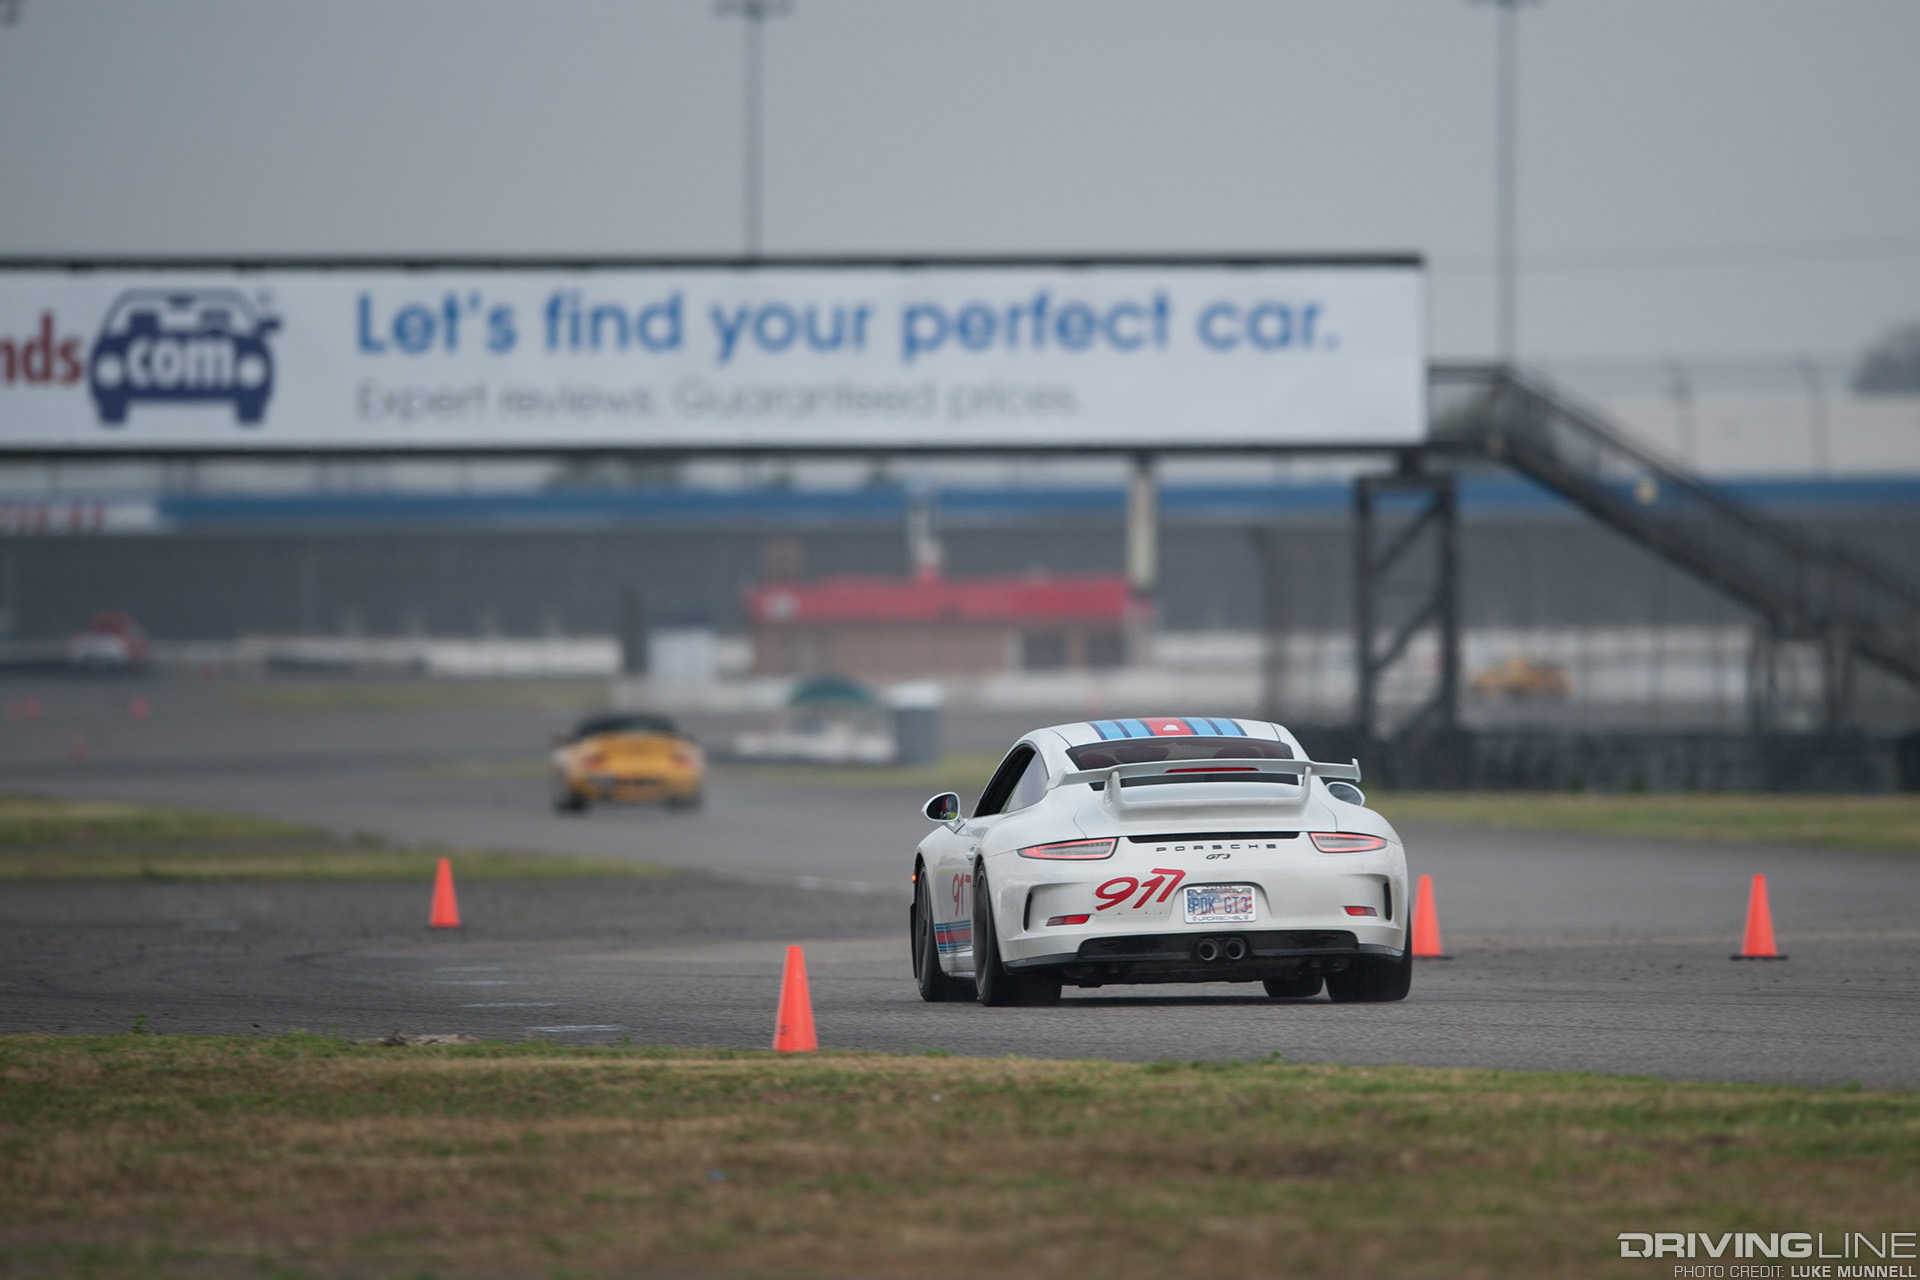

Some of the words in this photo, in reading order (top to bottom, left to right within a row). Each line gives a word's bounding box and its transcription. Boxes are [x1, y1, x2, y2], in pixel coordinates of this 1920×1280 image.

[355, 289, 517, 356] Let's
[545, 288, 685, 353] find
[709, 300, 875, 365] your
[900, 290, 1172, 365] perfect
[1195, 299, 1340, 352] car.
[126, 336, 236, 390] com
[356, 378, 488, 427] Expert
[670, 372, 938, 422] Guaranteed
[1156, 843, 1277, 853] PORSCHE
[1095, 867, 1187, 912] 917
[1192, 897, 1216, 914] PDK
[1224, 896, 1248, 914] GT3
